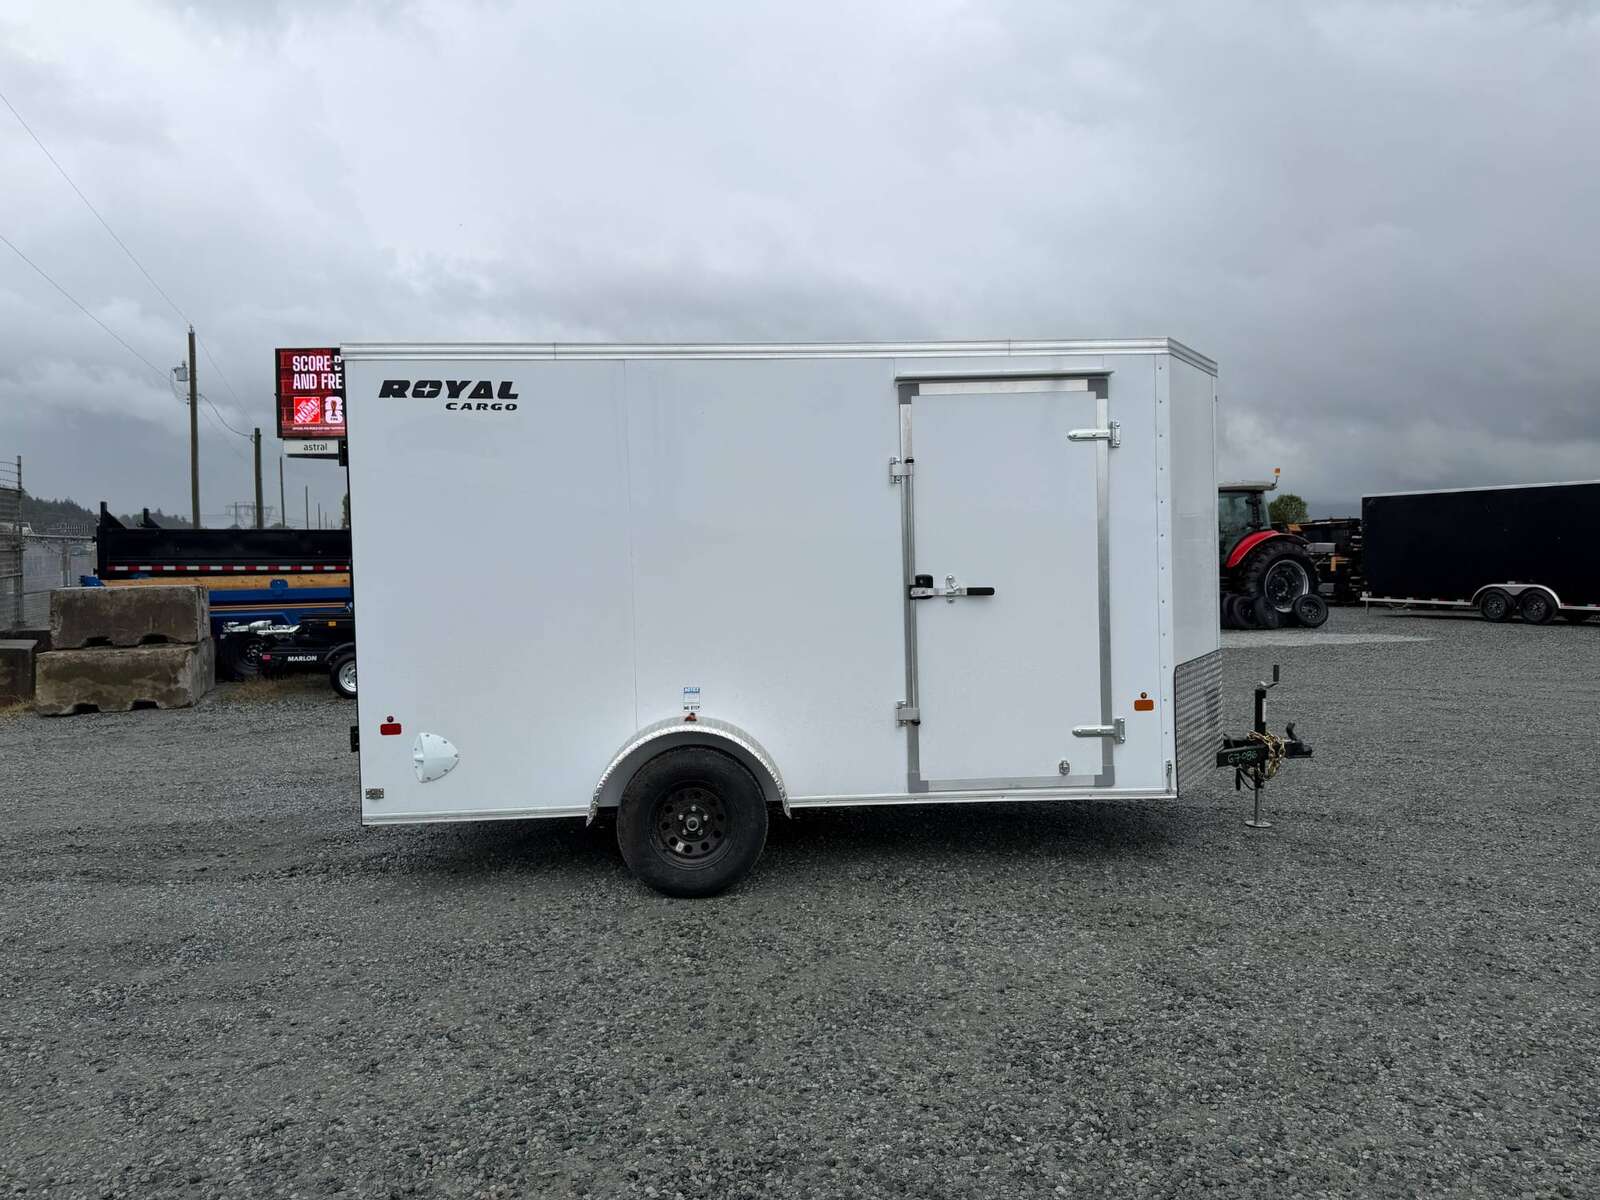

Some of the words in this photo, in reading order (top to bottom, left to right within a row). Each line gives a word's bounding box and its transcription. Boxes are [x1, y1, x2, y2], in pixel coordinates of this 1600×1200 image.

[293, 355, 330, 371] SCORE
[293, 373, 317, 390] AND
[321, 373, 343, 389] FRE
[378, 379, 519, 400] ROYAL
[445, 402, 518, 411] CARGO
[303, 443, 327, 451] astral
